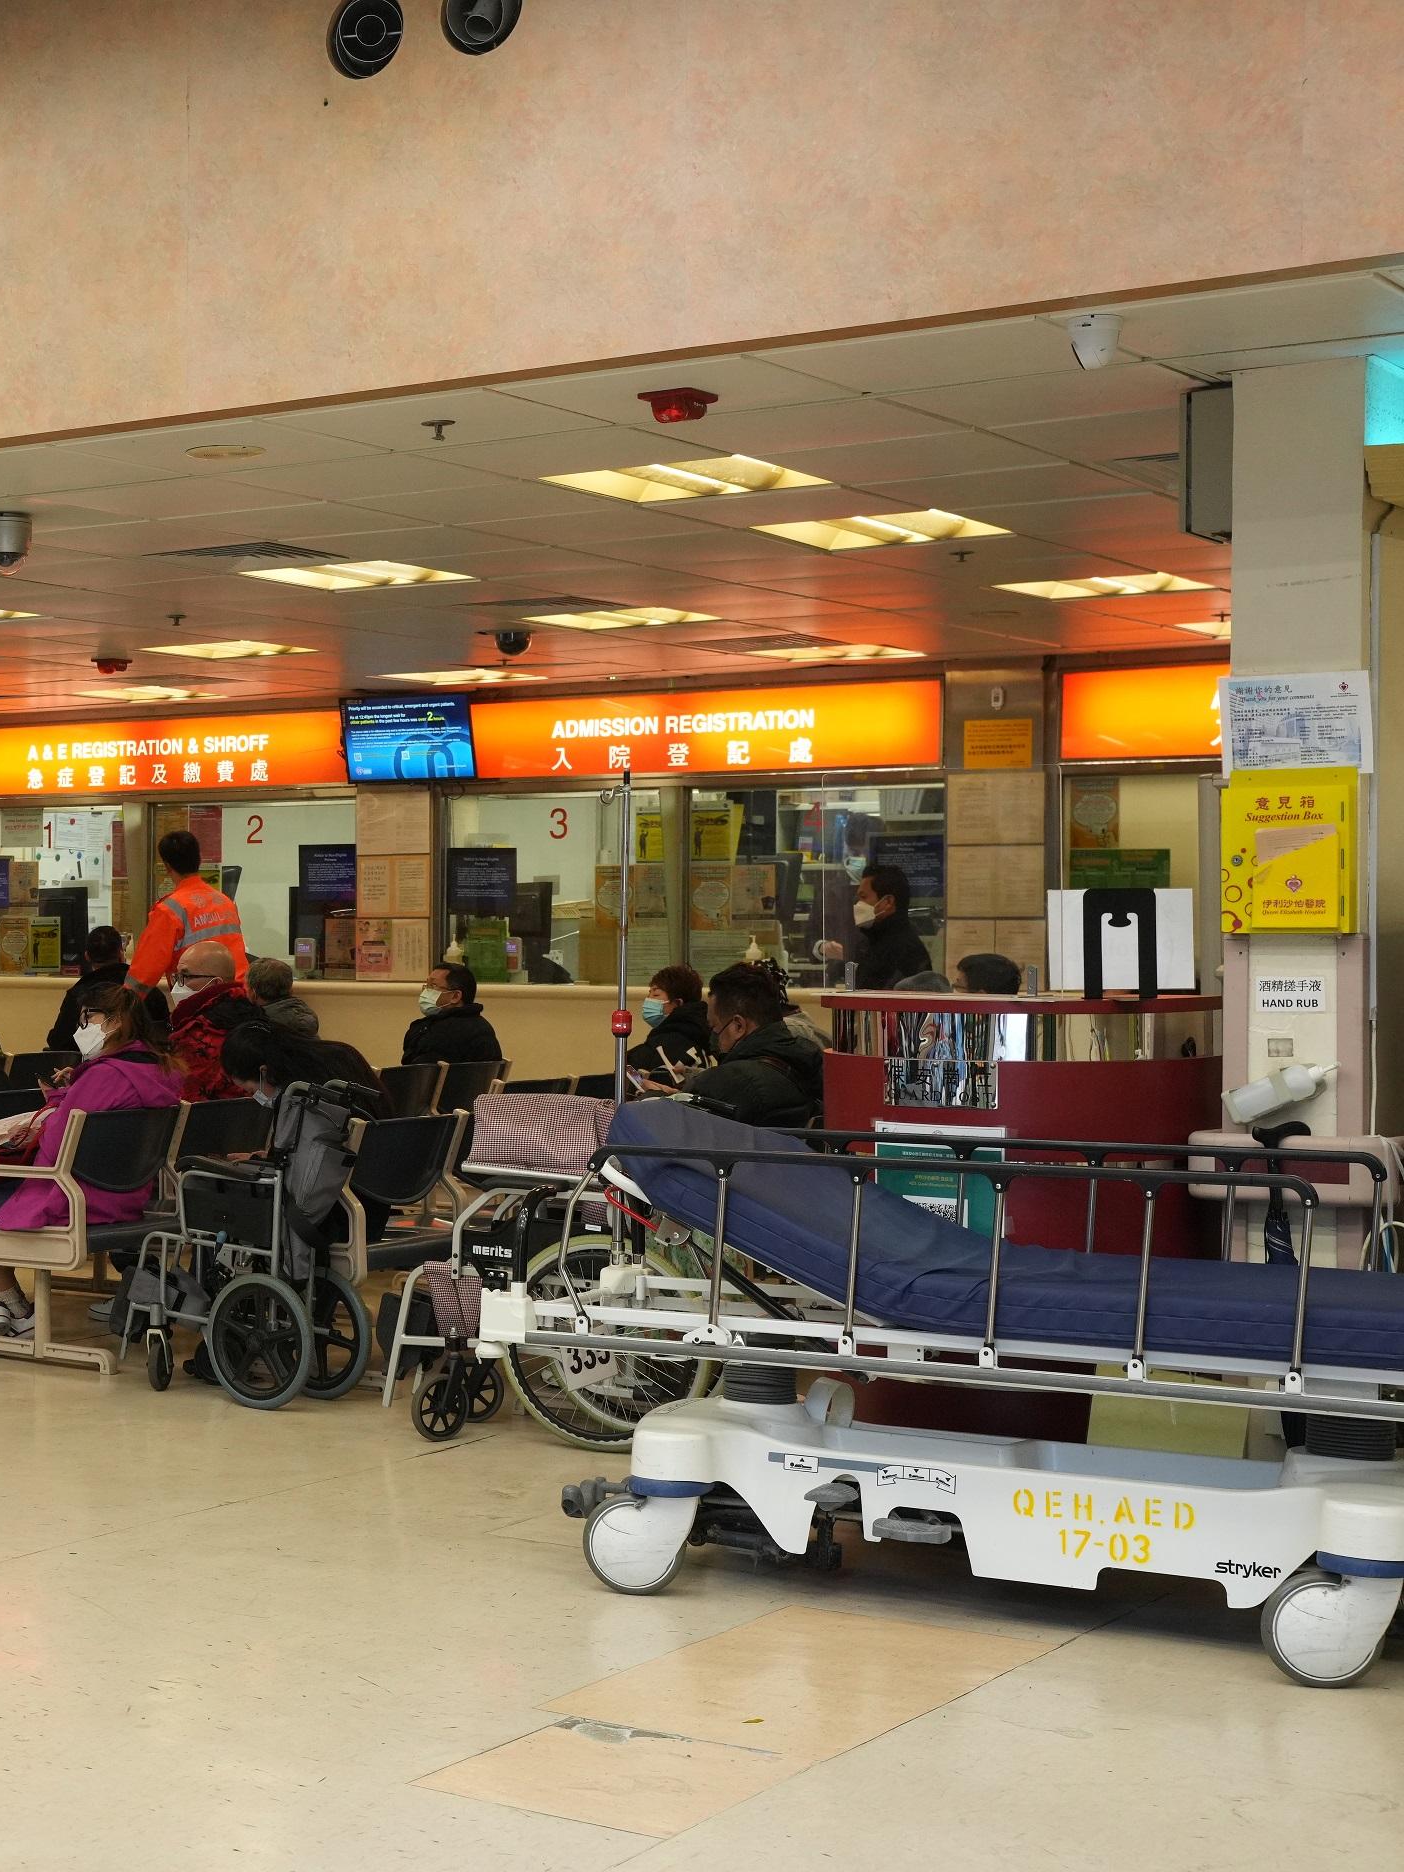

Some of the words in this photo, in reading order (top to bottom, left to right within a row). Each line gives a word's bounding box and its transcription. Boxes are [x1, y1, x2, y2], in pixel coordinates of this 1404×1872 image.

[427, 711, 433, 721] 2
[551, 715, 659, 739] ADMISSION
[665, 708, 815, 734] REGISTRATION
[27, 744, 39, 761] A
[42, 744, 53, 761] &
[57, 743, 67, 760] E
[72, 738, 183, 759] REGISTRATION
[187, 737, 199, 753] &
[203, 734, 269, 753] SHROFF
[551, 737, 813, 771] 入院登記處
[27, 759, 269, 789] 急症登記及繳費處
[1255, 796, 1315, 811] 意見箱
[549, 807, 567, 839] 3
[1245, 811, 1300, 824] Suggestion
[1303, 811, 1324, 820] Box
[44, 821, 52, 849] 1
[246, 815, 263, 844] 2
[1262, 899, 1326, 909] 伊利沙伯醫院
[1259, 979, 1322, 992] 酒精搓手液
[1262, 999, 1293, 1008] HAND
[1296, 999, 1319, 1008] RUB
[950, 1091, 992, 1102] POST
[472, 1245, 513, 1258] merits
[1059, 1528, 1152, 1564] 17-03
[1214, 1559, 1282, 1579] stryker
